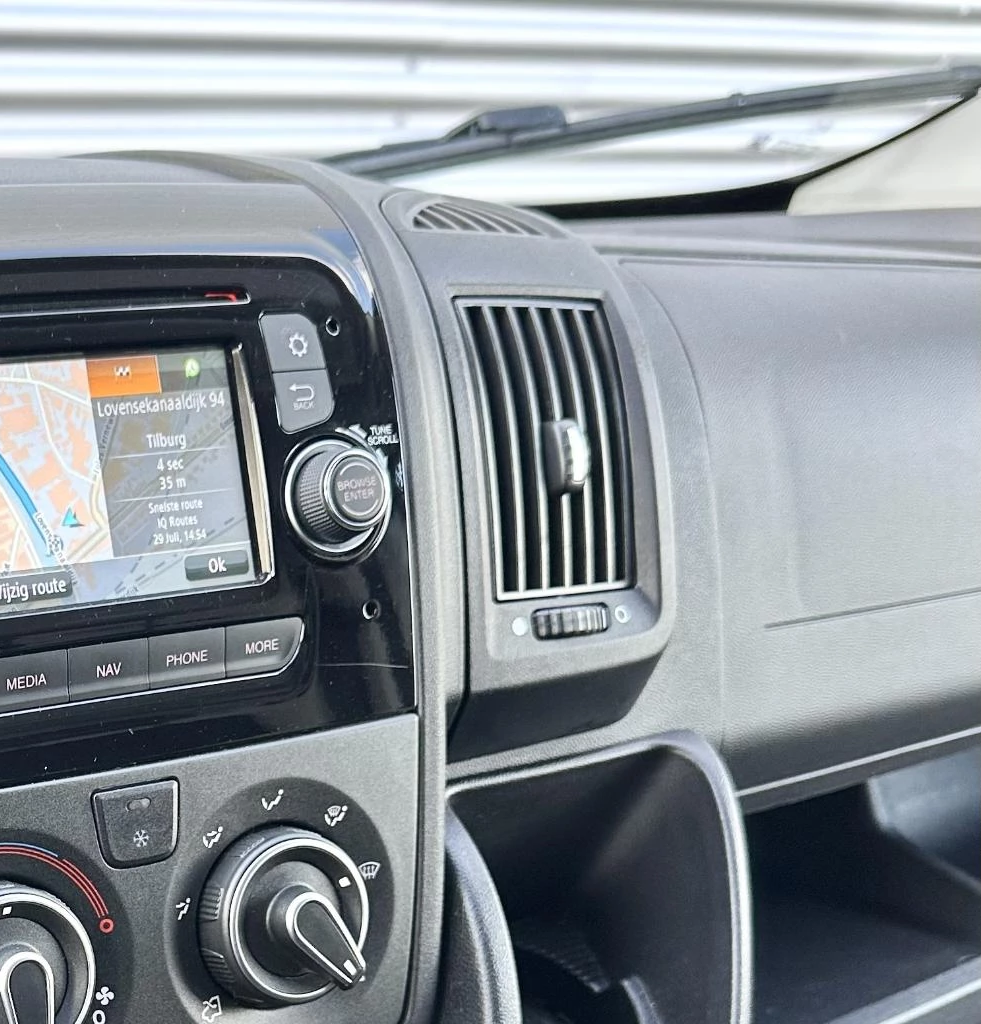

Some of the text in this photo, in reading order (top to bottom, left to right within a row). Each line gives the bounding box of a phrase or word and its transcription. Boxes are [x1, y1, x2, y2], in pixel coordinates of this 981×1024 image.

[96, 391, 225, 418] Lovensekanaaldijk 94
[293, 401, 315, 411] BACK
[369, 423, 394, 436] TUNE
[146, 431, 187, 450] Tilburg
[367, 434, 400, 447] SCROLL
[157, 458, 184, 472] 4 sec
[159, 477, 186, 490] 35 m
[336, 476, 377, 491] BROWSE
[344, 488, 374, 502] ENTER
[148, 499, 203, 514] Snelste route
[157, 515, 198, 530] IQ Routes
[208, 555, 227, 574] Ok
[32, 577, 67, 596] route
[244, 638, 279, 655] MORE
[166, 649, 208, 667] PHONE
[96, 663, 122, 678] NAV
[6, 673, 47, 692] MEDIA
